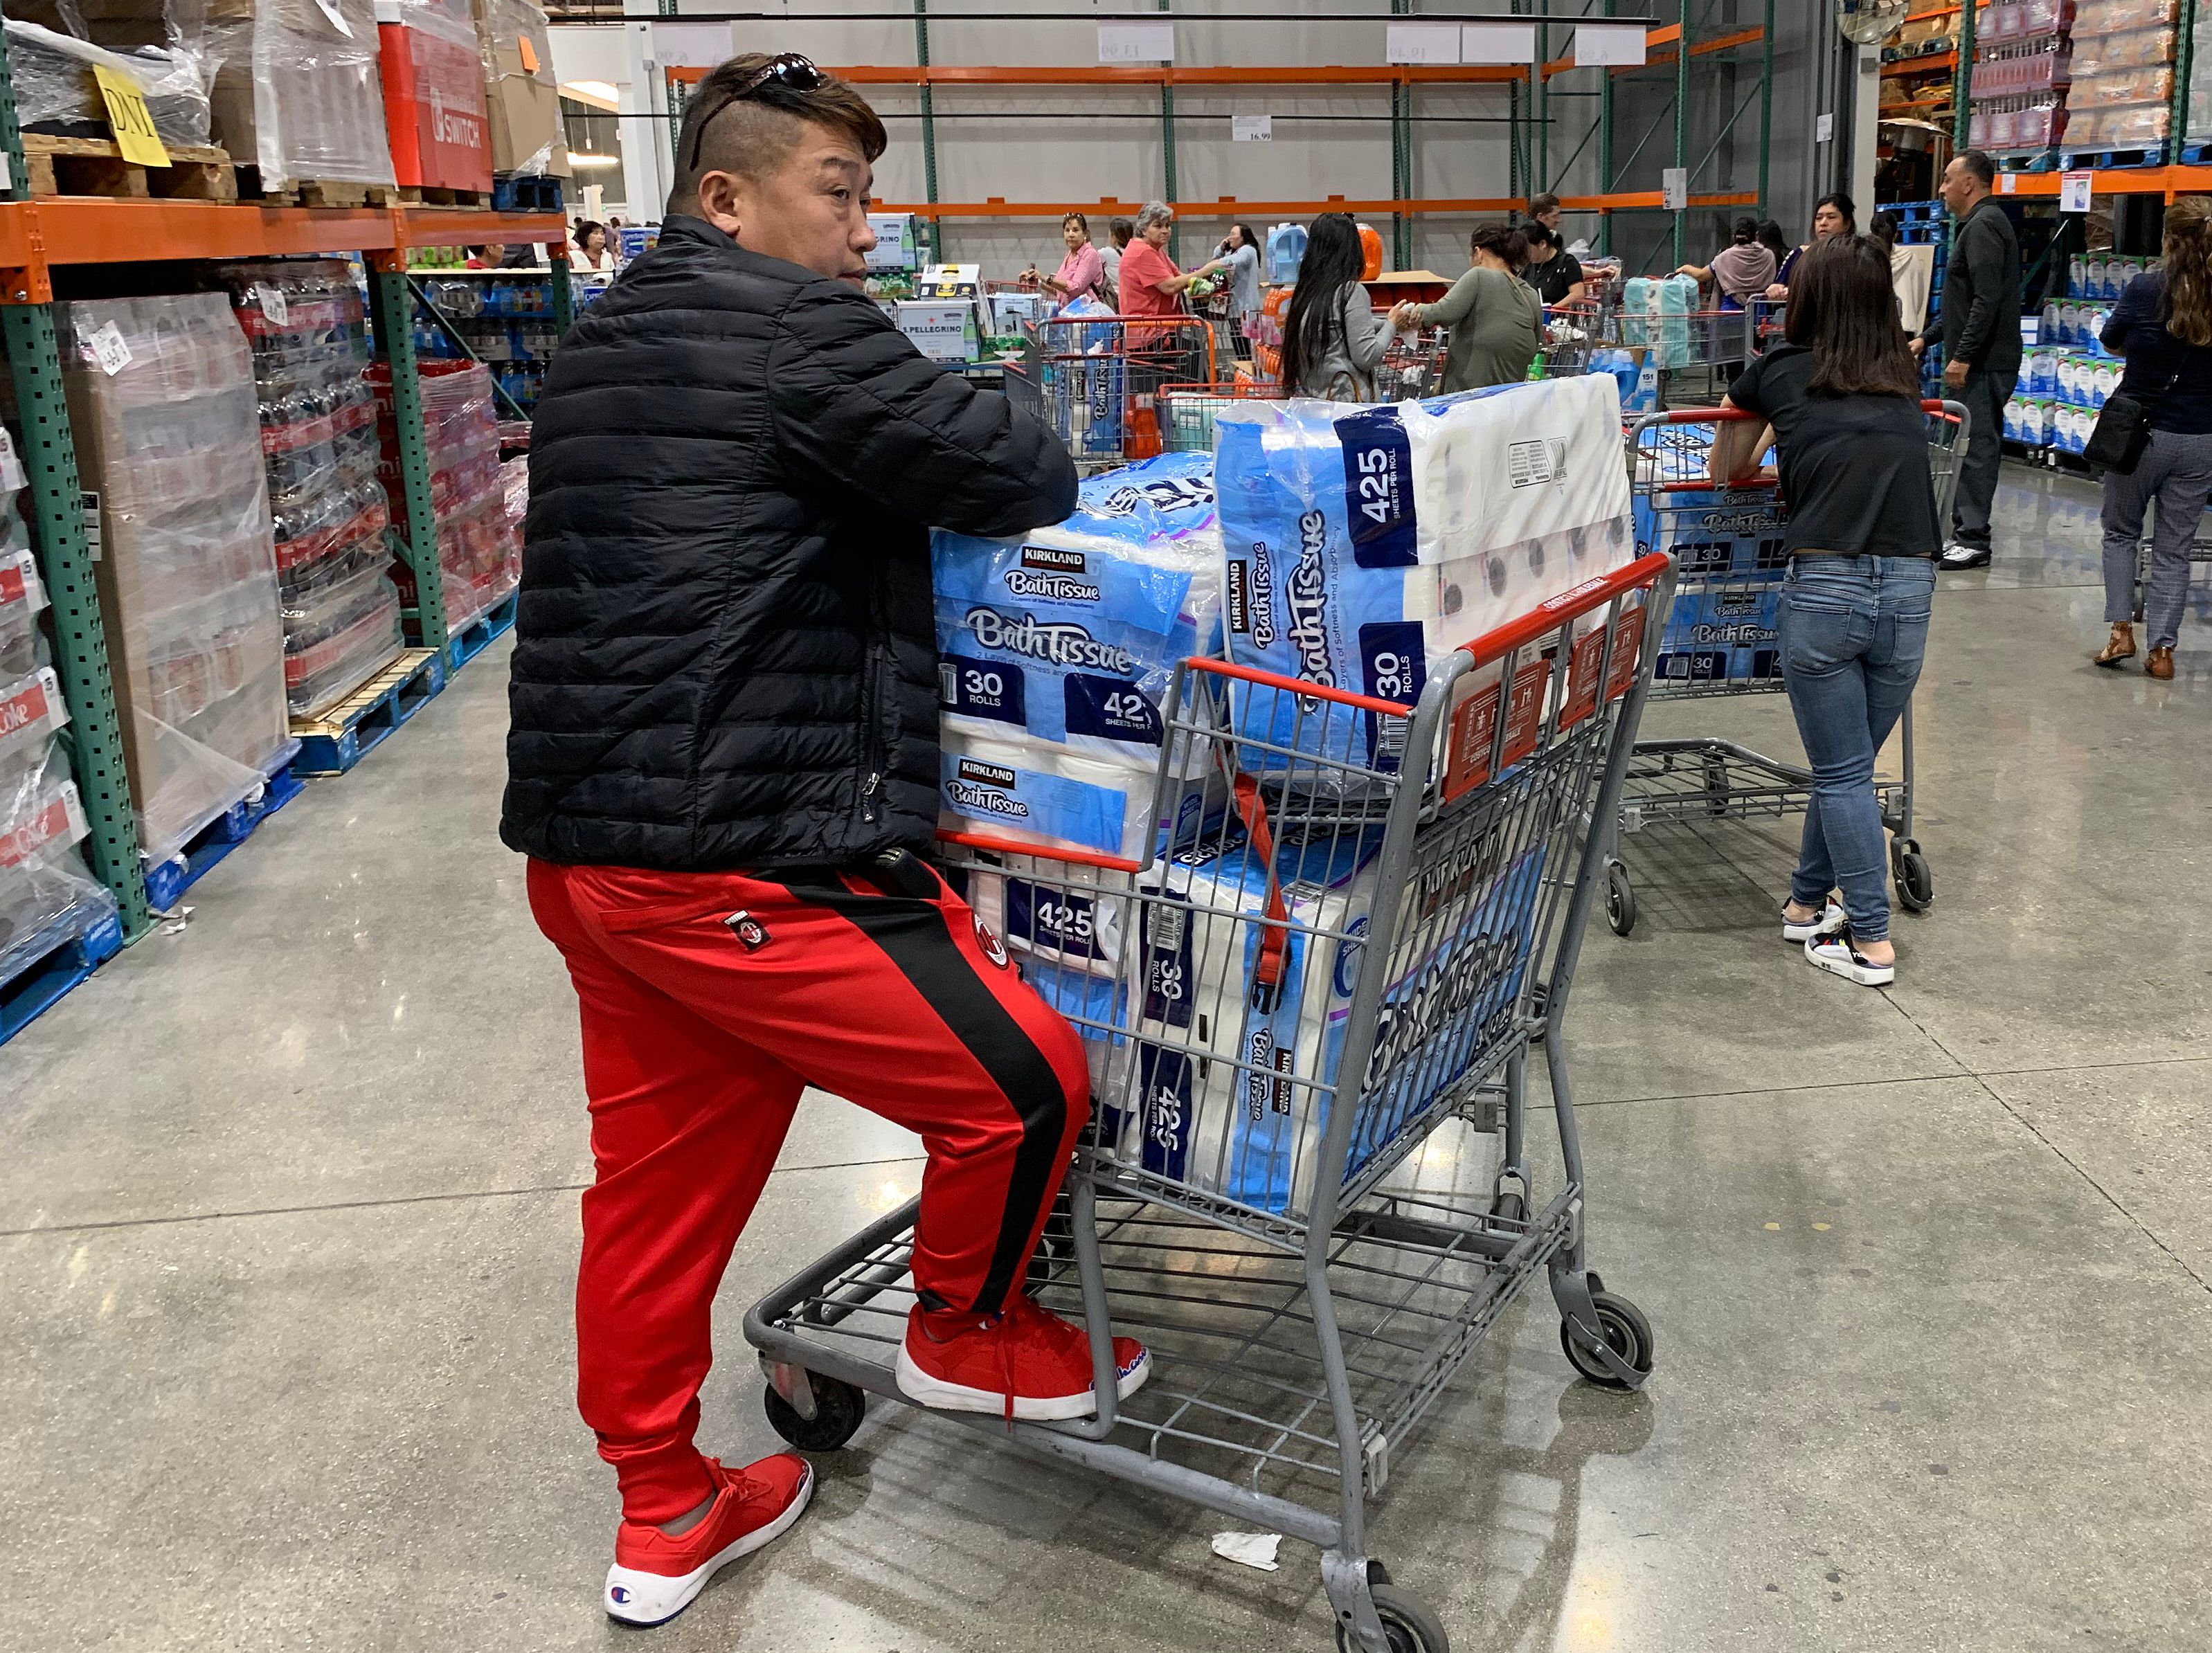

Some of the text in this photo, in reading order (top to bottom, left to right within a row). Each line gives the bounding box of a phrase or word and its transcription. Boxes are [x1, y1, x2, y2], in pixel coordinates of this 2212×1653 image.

[103, 88, 154, 138] DNI
[1358, 449, 1390, 523] 425
[1391, 489, 1401, 519] SHEETS
[1025, 548, 1083, 565] KIRKLAND
[1702, 548, 1721, 560] 30
[1005, 570, 1099, 601] BathTissue
[1230, 562, 1243, 630] KIRKLAND
[1250, 541, 1274, 649] BathTissue
[965, 608, 1133, 674] BathTissue
[1333, 603, 1343, 645] Softness
[1338, 647, 1345, 658] of
[1694, 658, 1712, 669] 30
[965, 669, 1003, 696] 30
[1374, 652, 1401, 698] 30
[1401, 656, 1412, 692] ROLLS
[970, 694, 1001, 707] ROLLS
[1105, 718, 1132, 728] SHEETS
[962, 761, 1014, 782] KIRKLAND
[946, 780, 1029, 818] BathTissue
[1038, 901, 1092, 937] 425
[1152, 960, 1160, 993] ROLLS
[1161, 959, 1183, 1000] 30
[1156, 1086, 1181, 1151] 425
